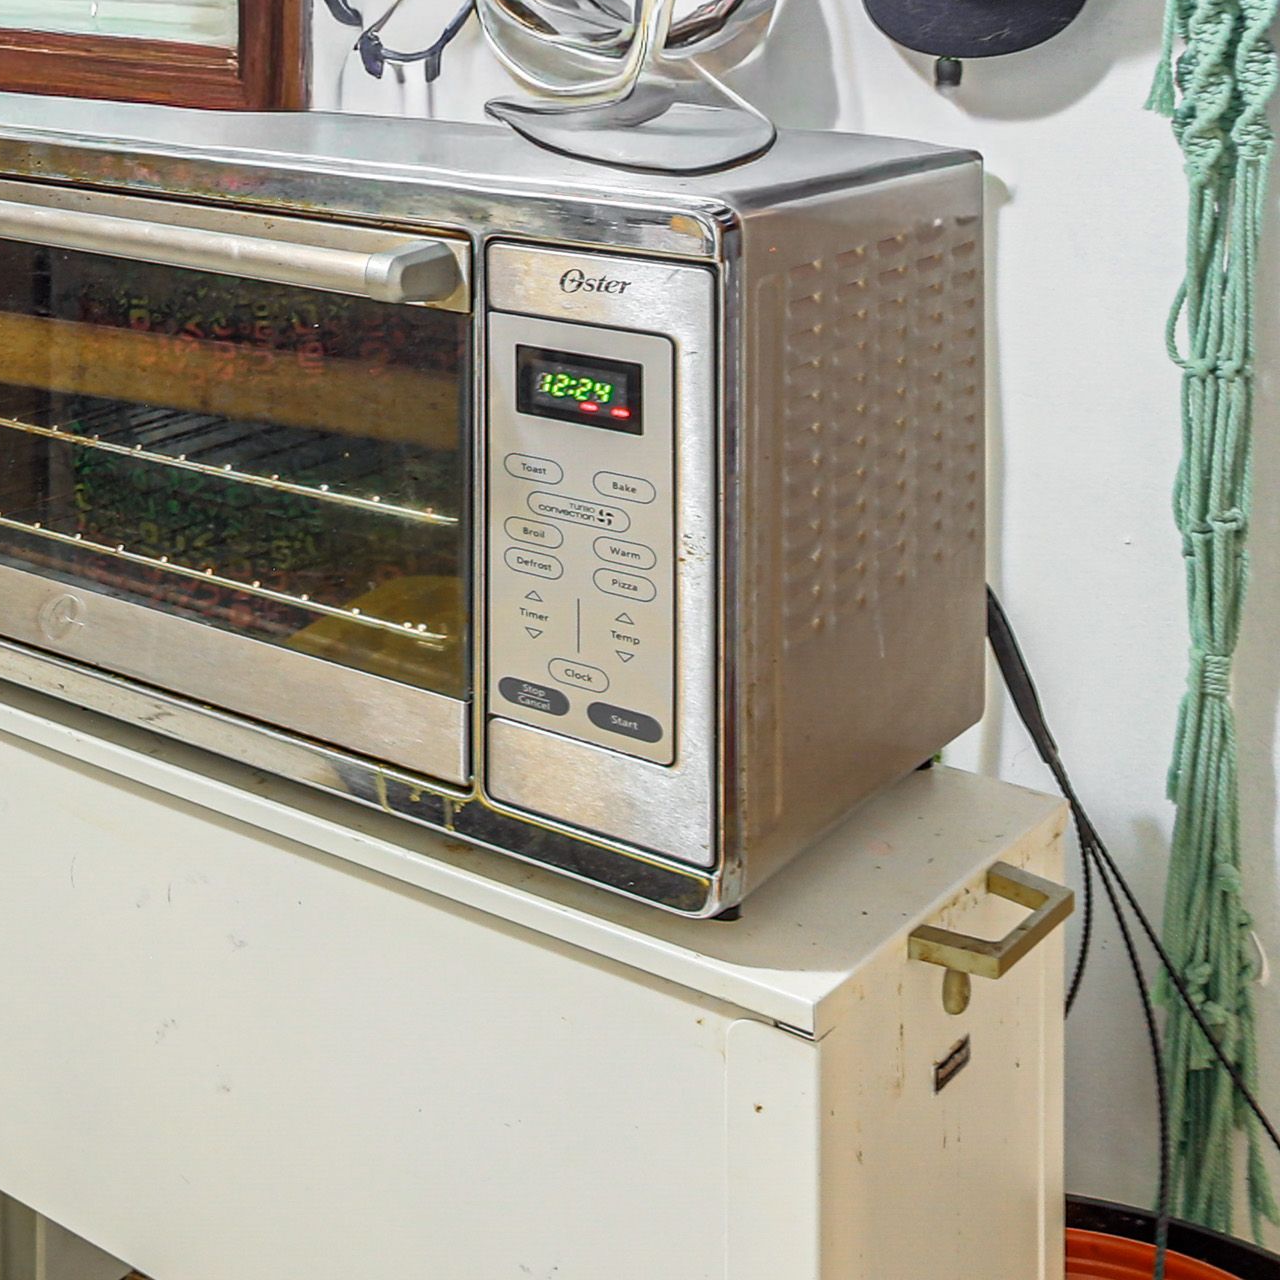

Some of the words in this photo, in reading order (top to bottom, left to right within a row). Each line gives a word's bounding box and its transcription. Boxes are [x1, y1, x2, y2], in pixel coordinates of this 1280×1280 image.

[559, 268, 632, 294] Oster
[543, 373, 612, 403] 12:24
[521, 462, 547, 475] Toast
[611, 481, 638, 494] Bake
[522, 526, 545, 538] Broil
[609, 545, 641, 560] Warm
[516, 556, 552, 572] Defrost
[611, 578, 638, 592] Pizza
[519, 606, 549, 622] Timer
[610, 629, 641, 646] Temp
[564, 668, 593, 683] Clock
[522, 683, 547, 698] Stop
[517, 695, 551, 711] Cancel
[610, 714, 639, 730] Start
